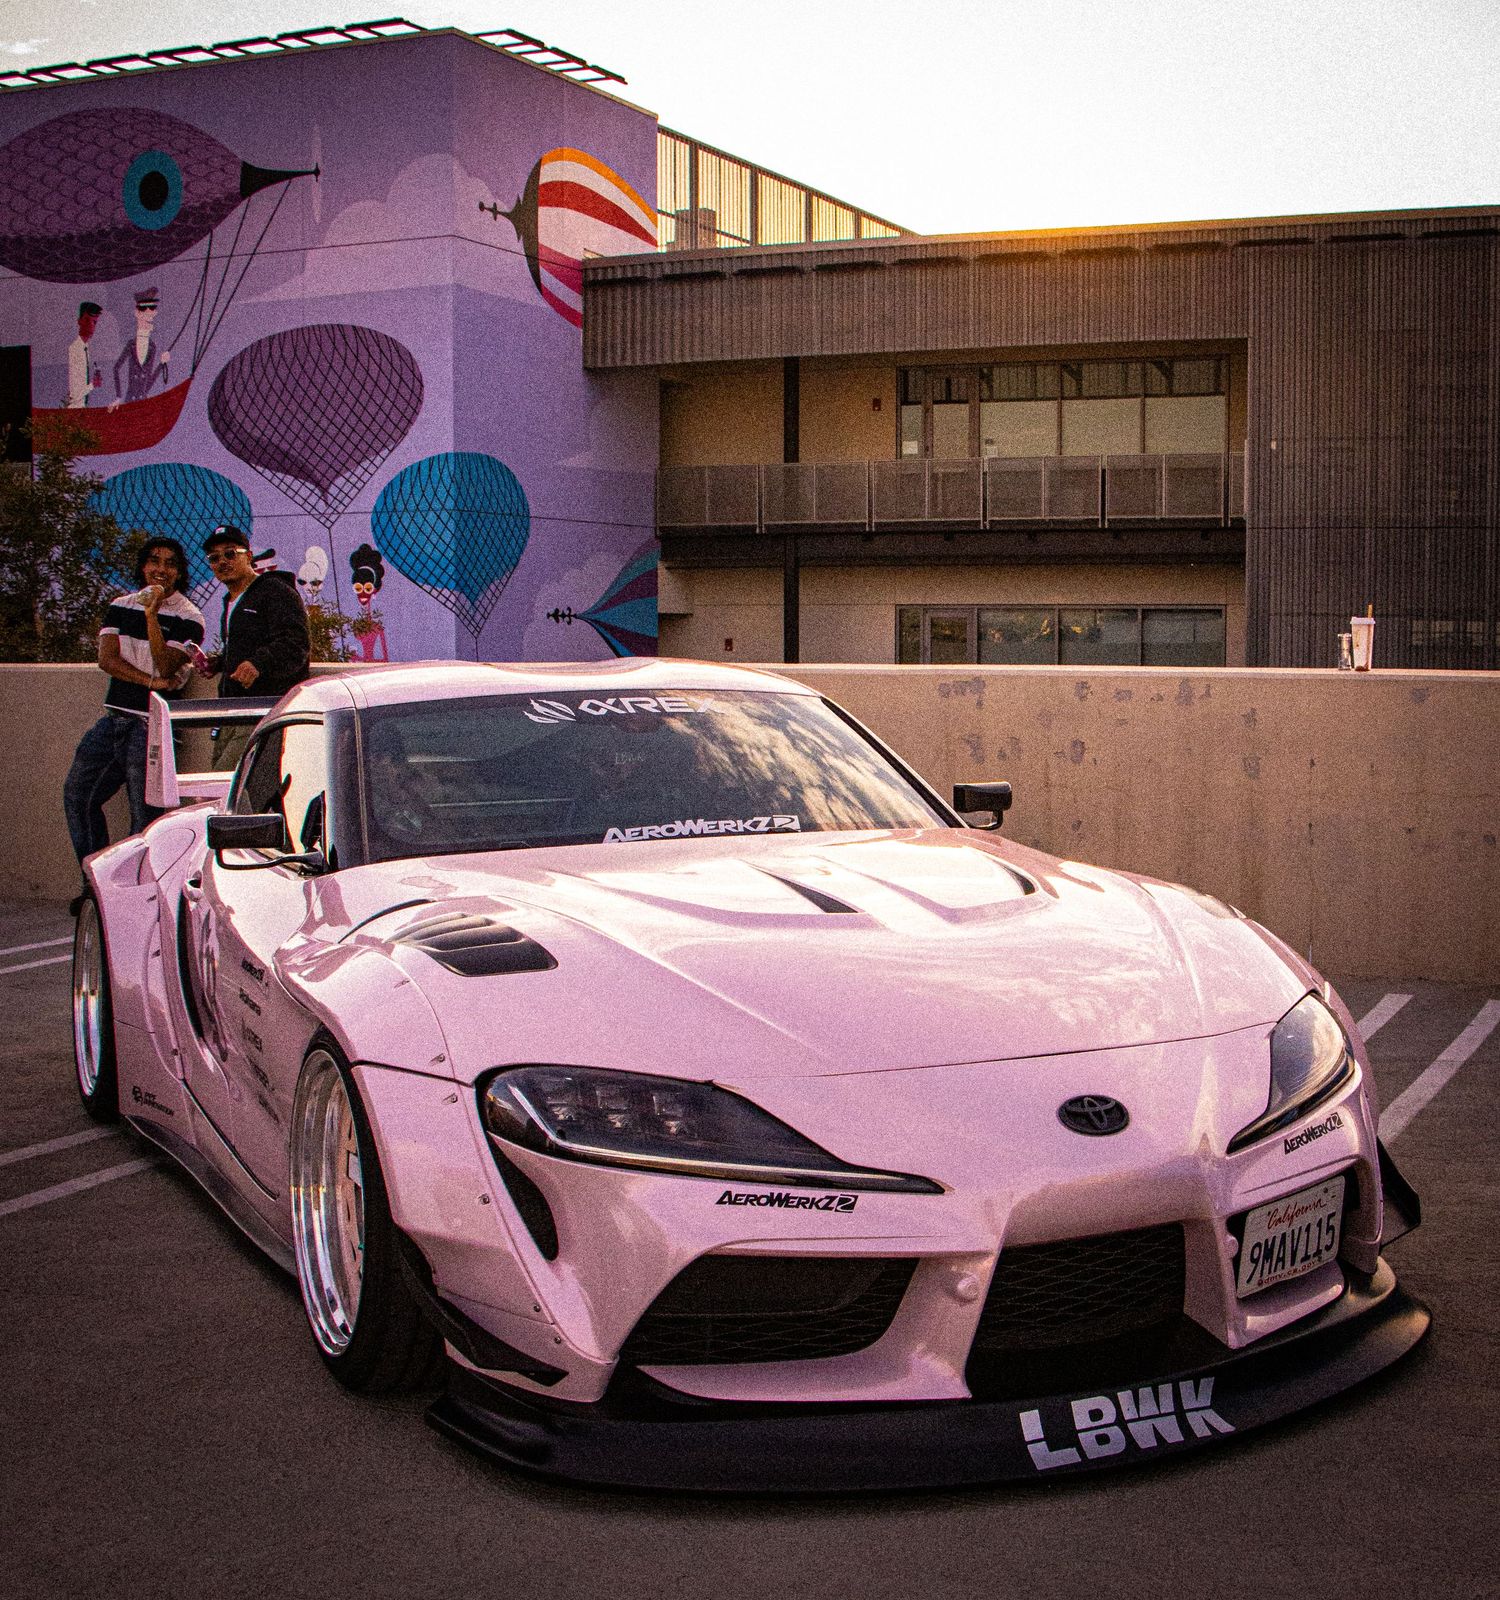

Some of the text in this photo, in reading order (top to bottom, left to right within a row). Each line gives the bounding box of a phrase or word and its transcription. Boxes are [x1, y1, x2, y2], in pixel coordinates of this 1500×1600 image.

[1246, 1212, 1336, 1284] 9MAV115
[1267, 1198, 1327, 1229] California
[1019, 1376, 1236, 1471] LBWK
